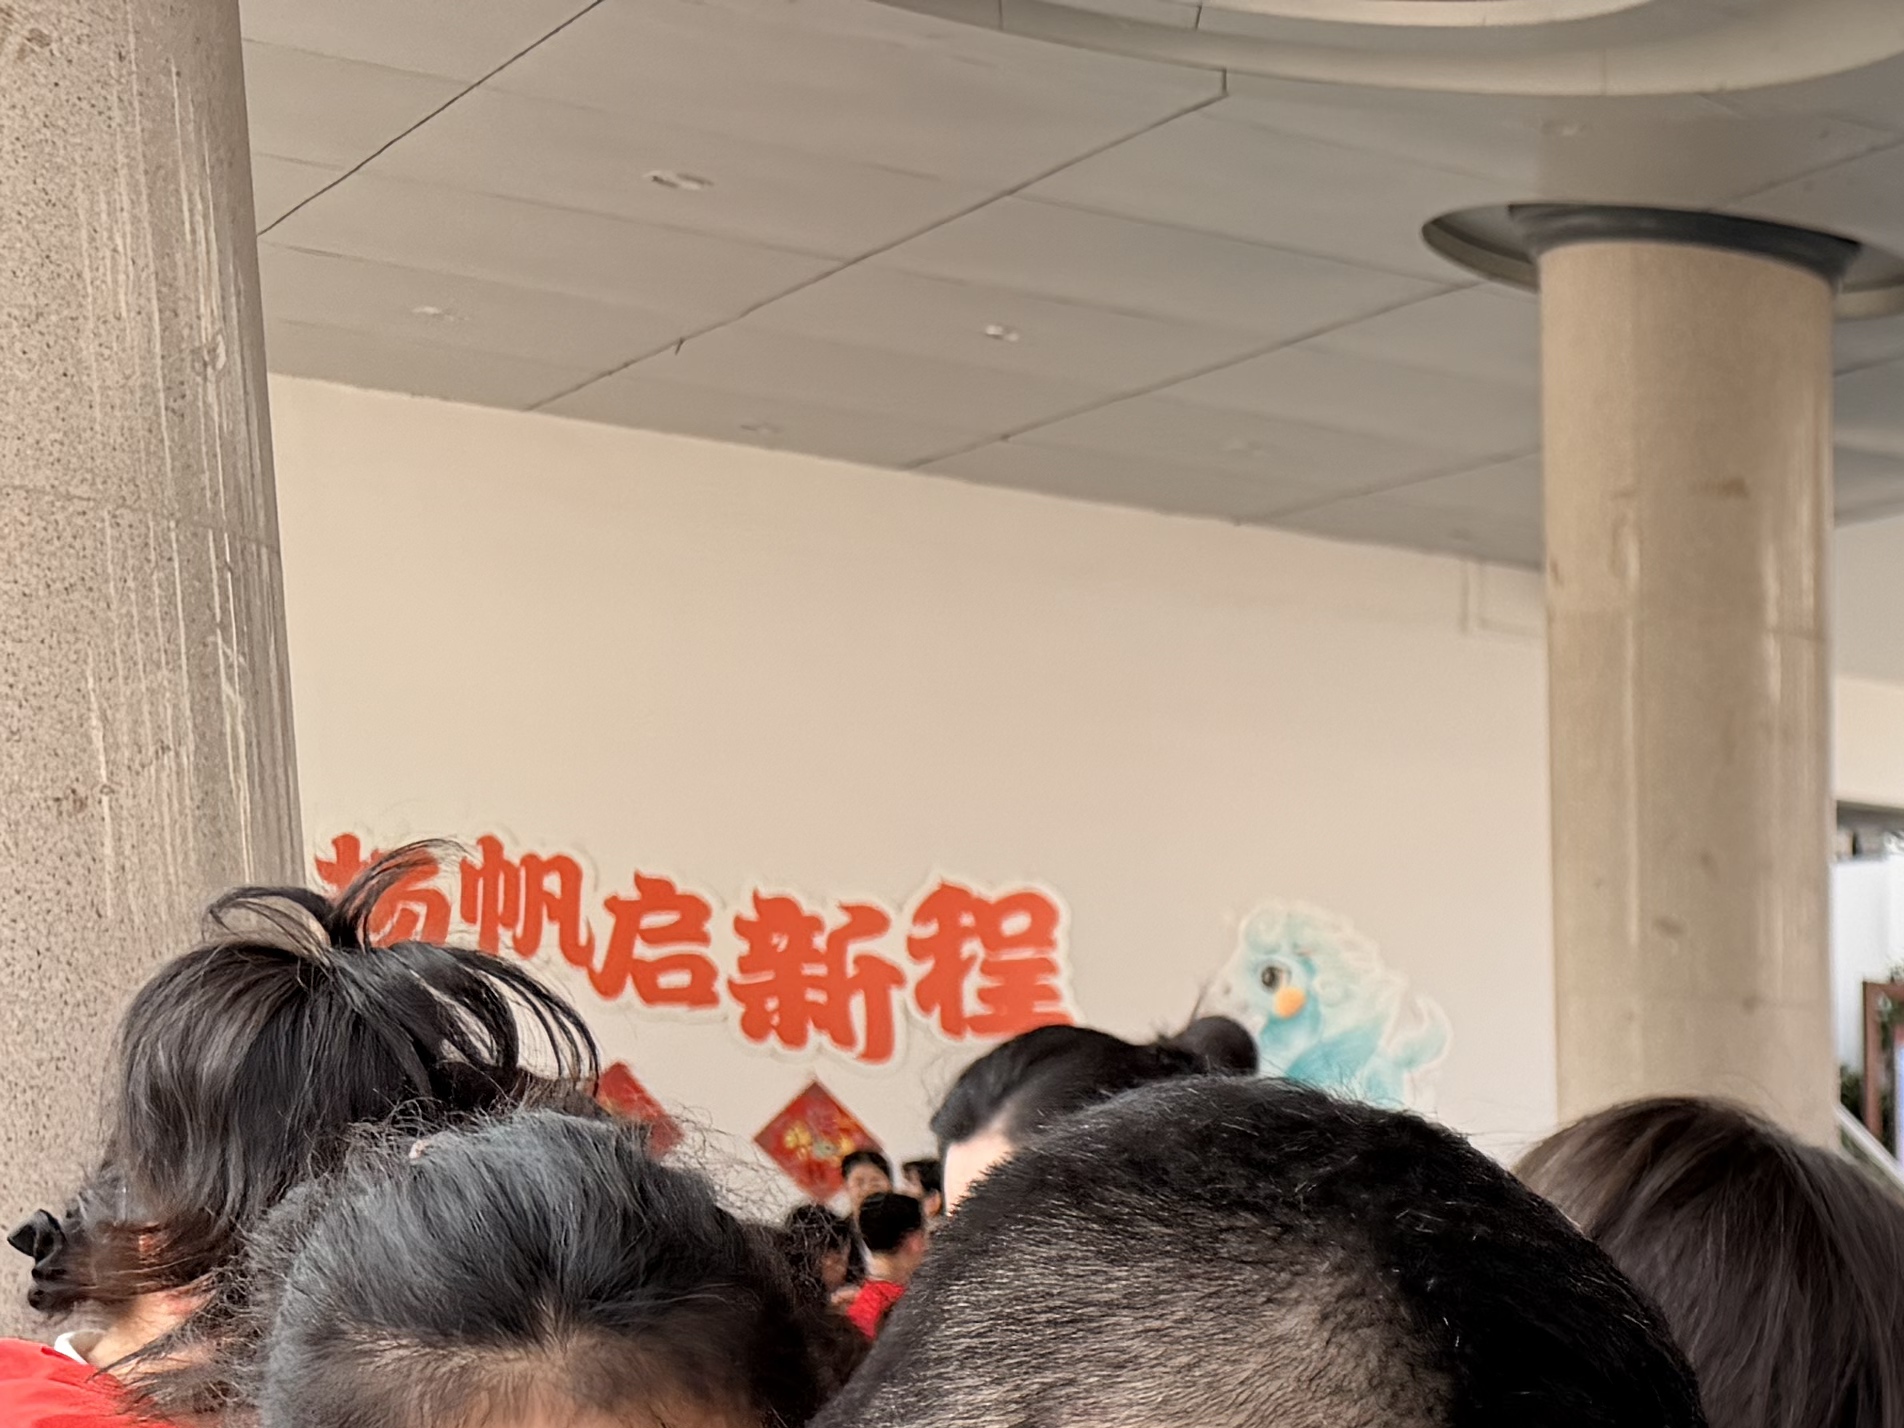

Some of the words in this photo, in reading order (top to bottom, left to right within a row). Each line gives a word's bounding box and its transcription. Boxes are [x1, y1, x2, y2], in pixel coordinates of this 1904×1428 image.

[316, 833, 1070, 1064] 扬帆启新程
